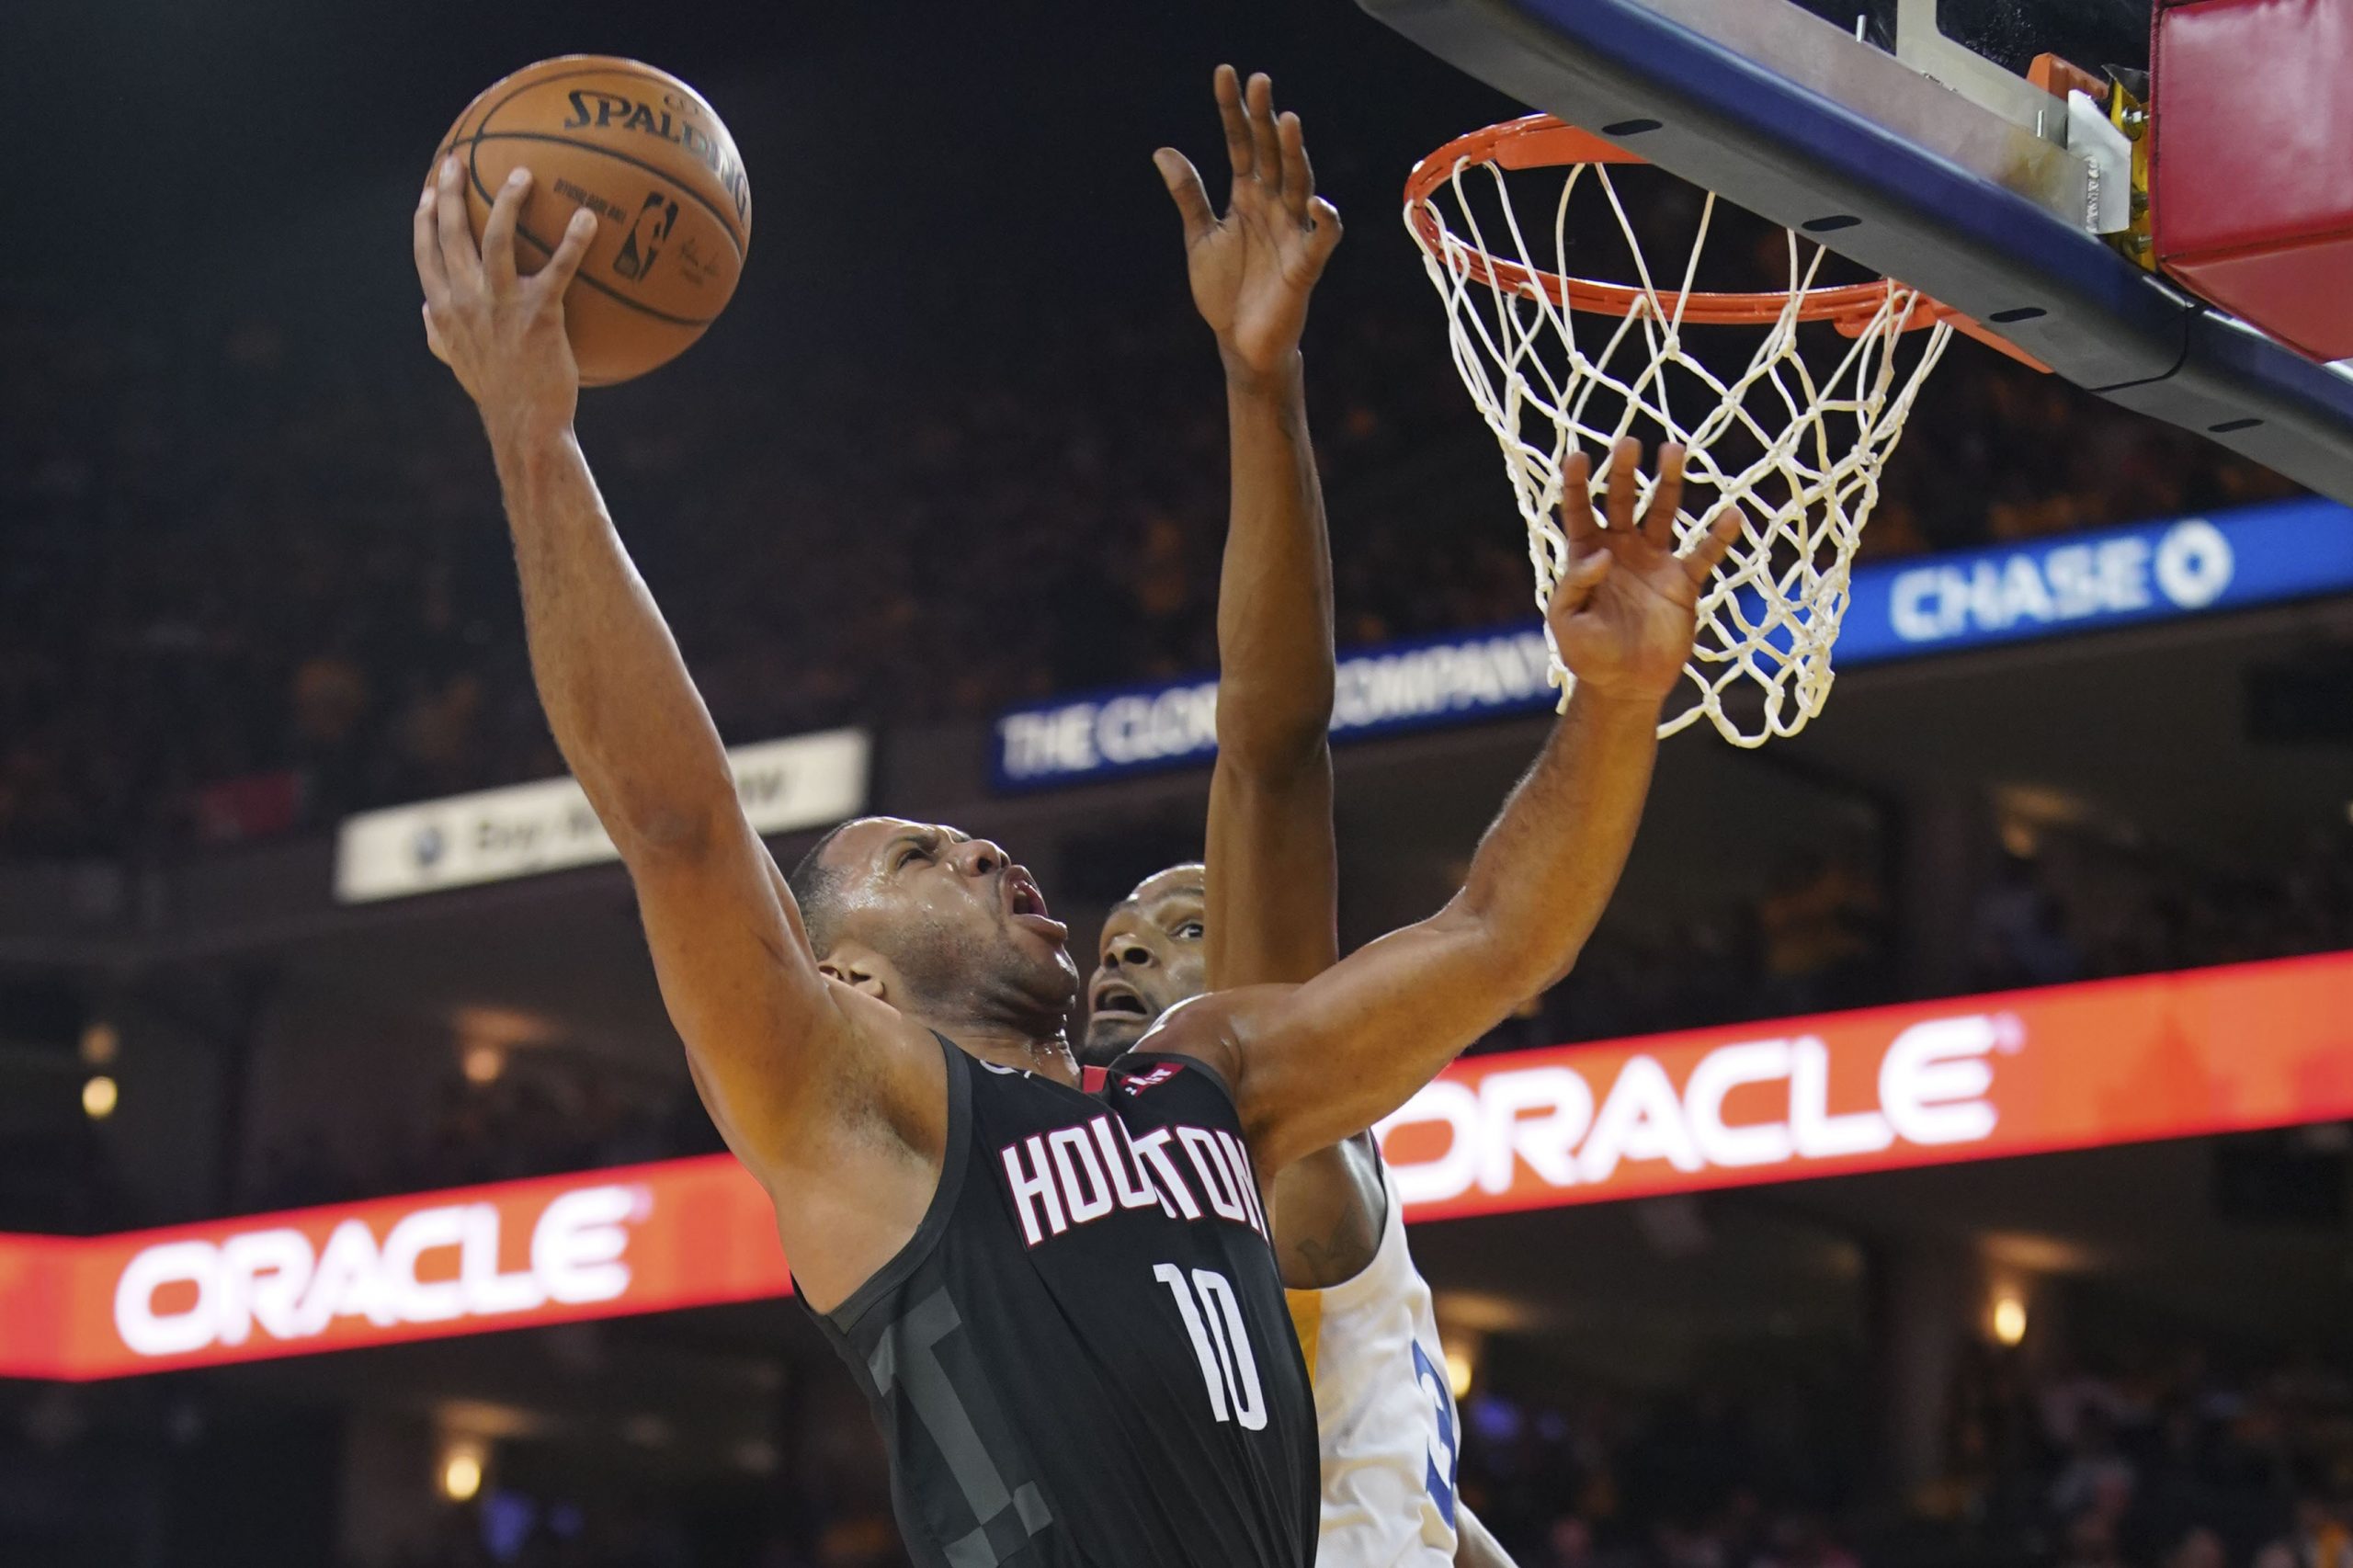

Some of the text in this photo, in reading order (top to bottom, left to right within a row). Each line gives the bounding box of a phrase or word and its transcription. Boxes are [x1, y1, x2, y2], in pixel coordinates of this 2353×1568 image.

[564, 89, 748, 223] SPALDING
[1891, 537, 2152, 642] CHASE
[1000, 1111, 1270, 1247] HOUTON
[1375, 1015, 1998, 1204] ORACLE
[115, 1185, 633, 1356] ORACLE
[1153, 1263, 1268, 1431] 10
